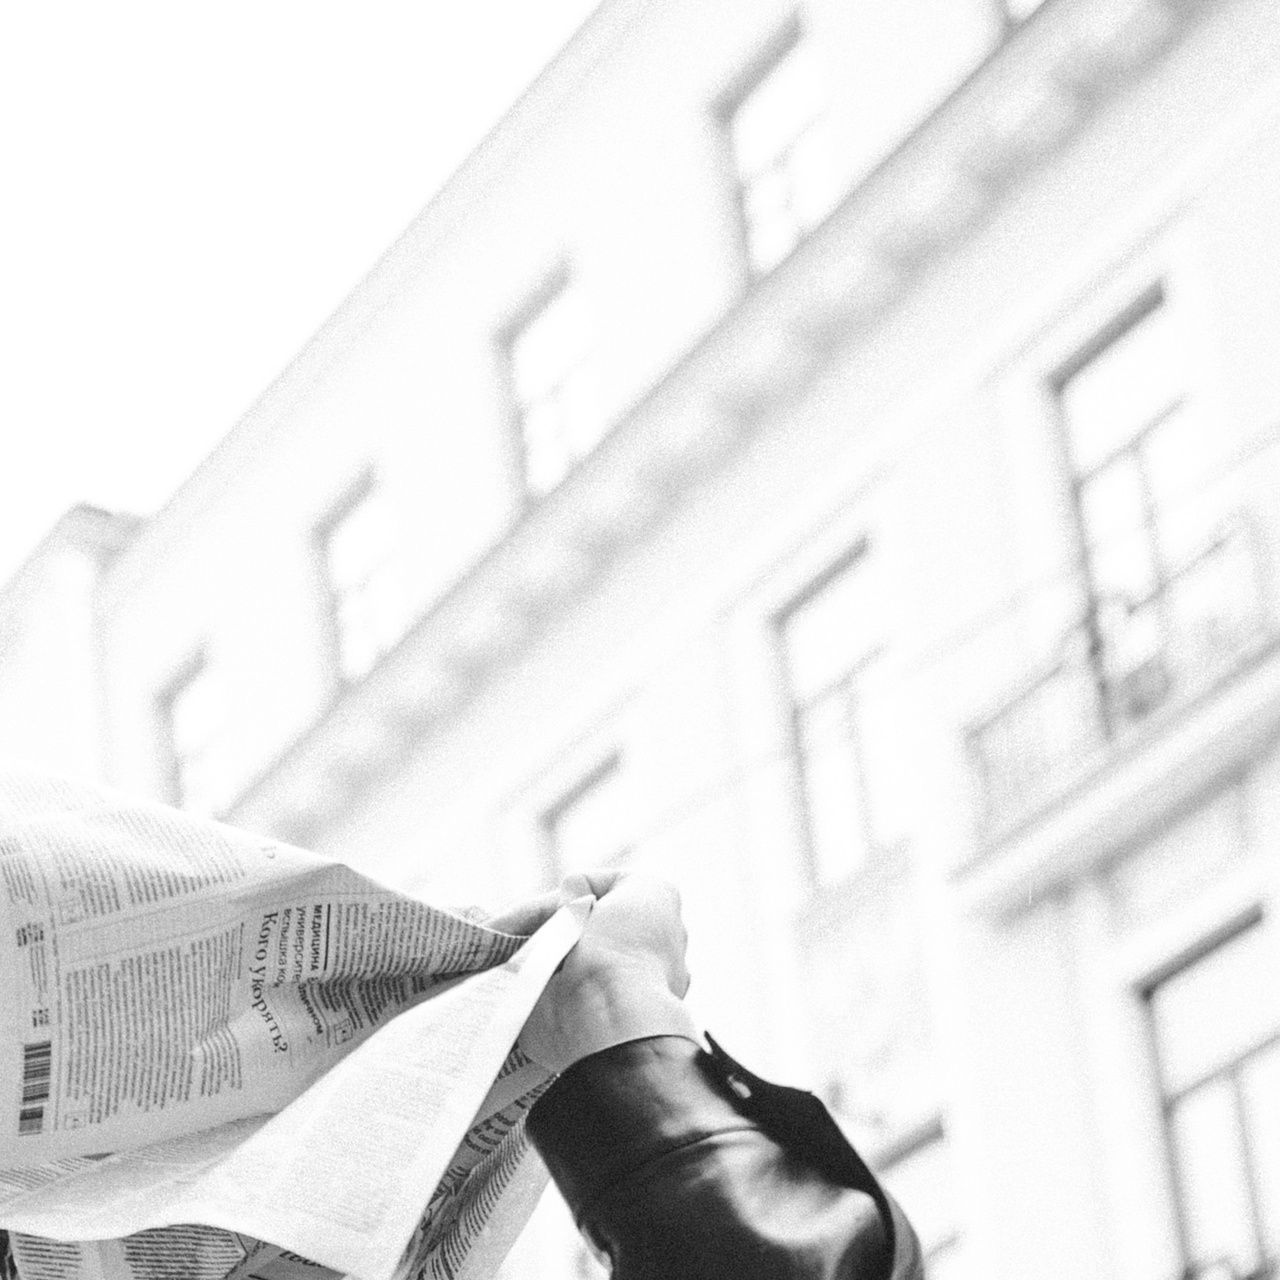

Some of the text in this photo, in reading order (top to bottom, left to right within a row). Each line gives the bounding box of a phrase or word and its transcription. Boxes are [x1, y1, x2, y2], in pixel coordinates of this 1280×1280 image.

[292, 905, 307, 985] университе
[310, 904, 323, 972] МЕДИЦИНА
[248, 911, 289, 1054] Кого укорять?
